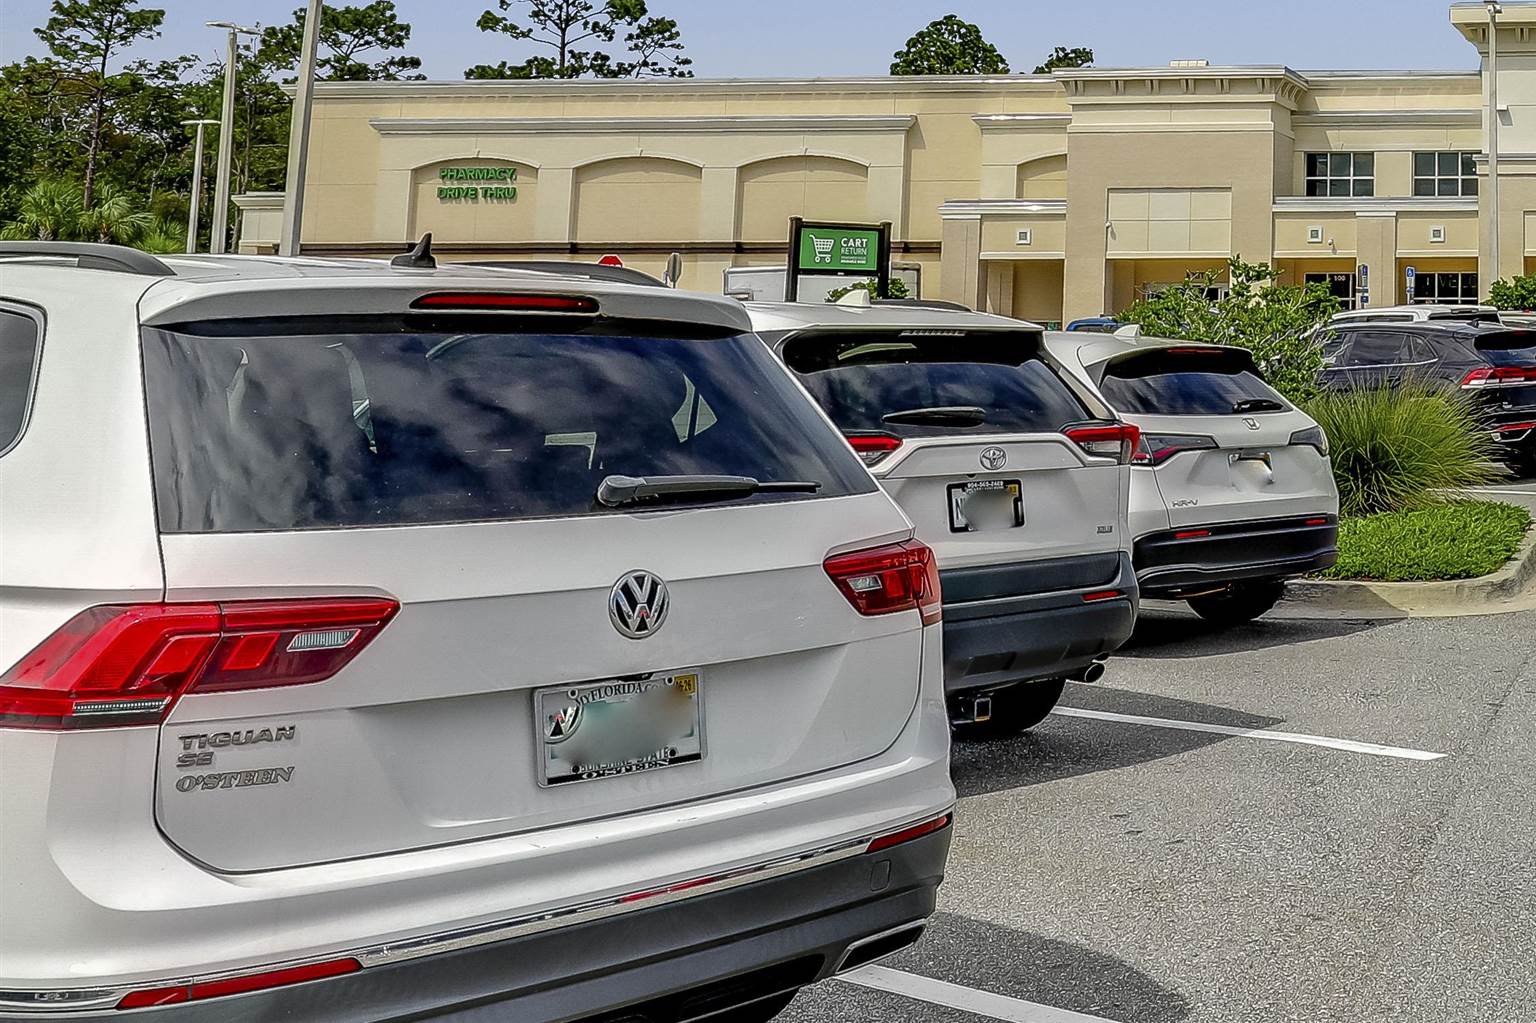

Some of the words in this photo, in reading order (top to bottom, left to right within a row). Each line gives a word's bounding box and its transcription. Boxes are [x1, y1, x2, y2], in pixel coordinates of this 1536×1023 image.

[440, 167, 516, 180] PHARMACY
[437, 186, 478, 199] DRIVE
[479, 186, 517, 199] THRU
[841, 238, 868, 248] CART
[841, 247, 867, 255] RETURN
[178, 725, 296, 751] TIGUAN
[176, 751, 215, 768] SE
[175, 766, 295, 792] O'STEEN
